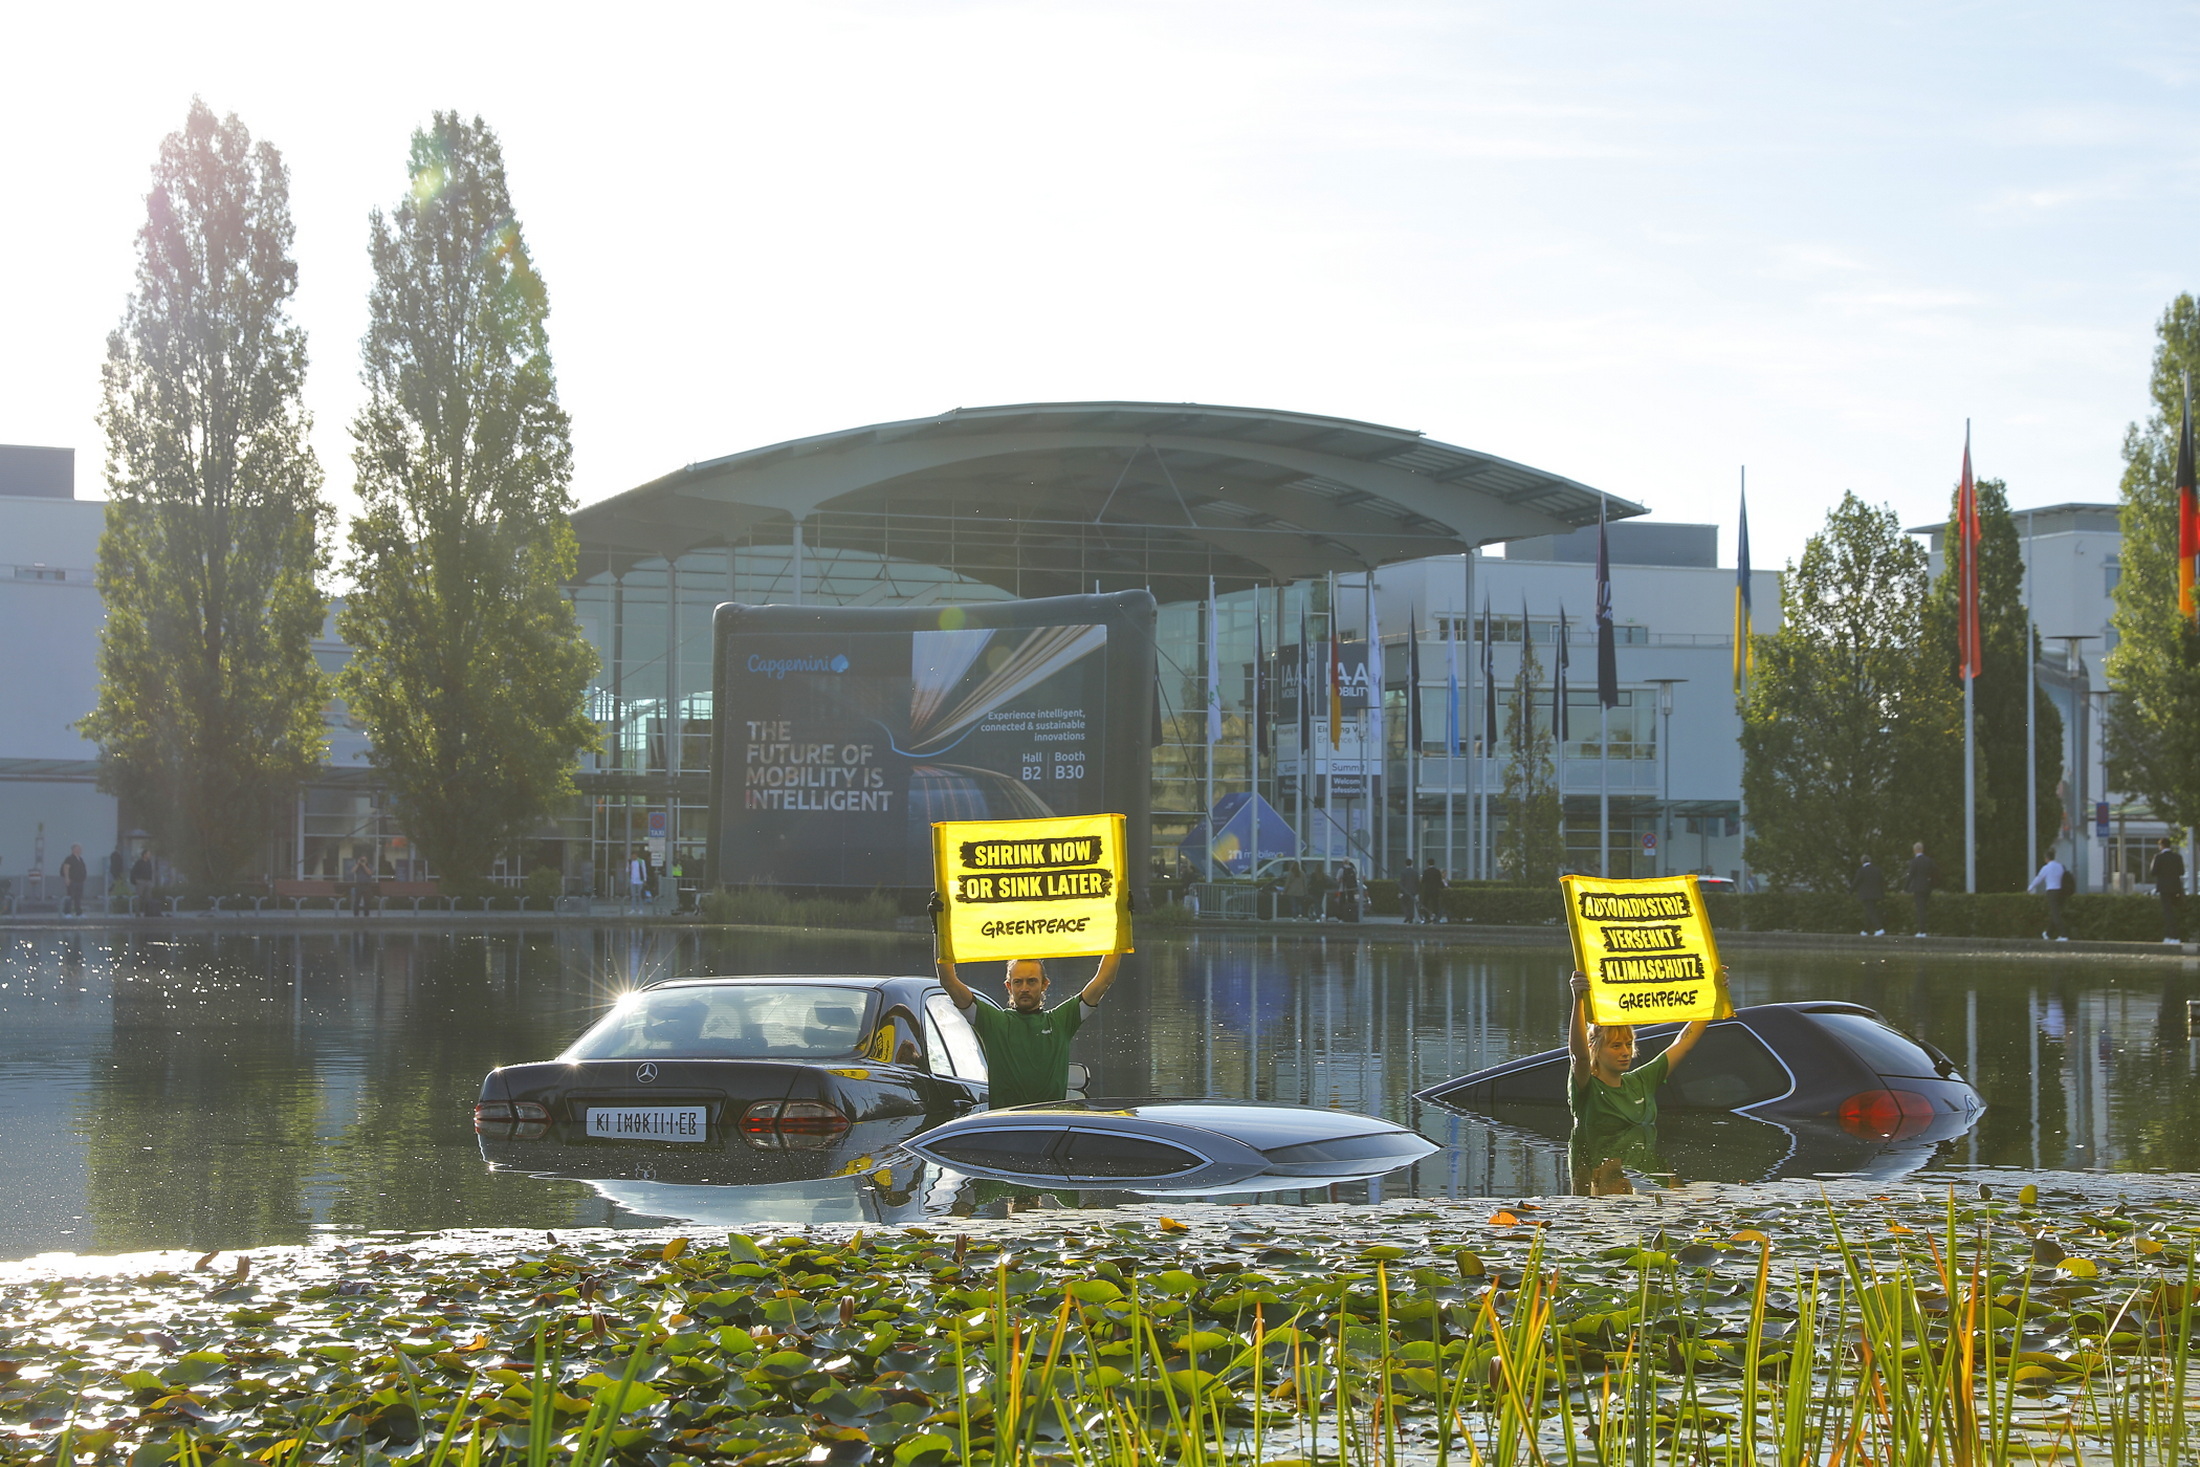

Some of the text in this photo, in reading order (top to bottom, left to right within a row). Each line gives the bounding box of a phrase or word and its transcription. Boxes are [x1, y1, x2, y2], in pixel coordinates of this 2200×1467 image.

[747, 654, 829, 680] Capgemini
[1325, 662, 1369, 686] IAA
[988, 708, 1086, 721] Experience intelligent,
[746, 720, 792, 742] THE
[980, 719, 1086, 732] connected & sustainable
[1034, 731, 1086, 742] innovations
[746, 744, 874, 765] FUTURE OF
[1022, 752, 1042, 763] Hall
[1054, 750, 1086, 762] Booth
[745, 766, 884, 788] MOBILITY IS
[1022, 766, 1042, 780] B2
[1055, 764, 1085, 779] B30
[745, 789, 893, 811] INTELLIGENT
[974, 840, 1091, 866] SHRINK NOW
[966, 873, 1103, 899] OR SINK LATER
[1585, 896, 1687, 918] AUTOINDUSTRIE
[981, 916, 1091, 938] GREENPEACE
[1607, 929, 1675, 949] VERSENKT
[1604, 958, 1699, 981] KLIMASCHUTZ
[1619, 990, 1698, 1011] GREENPEACE
